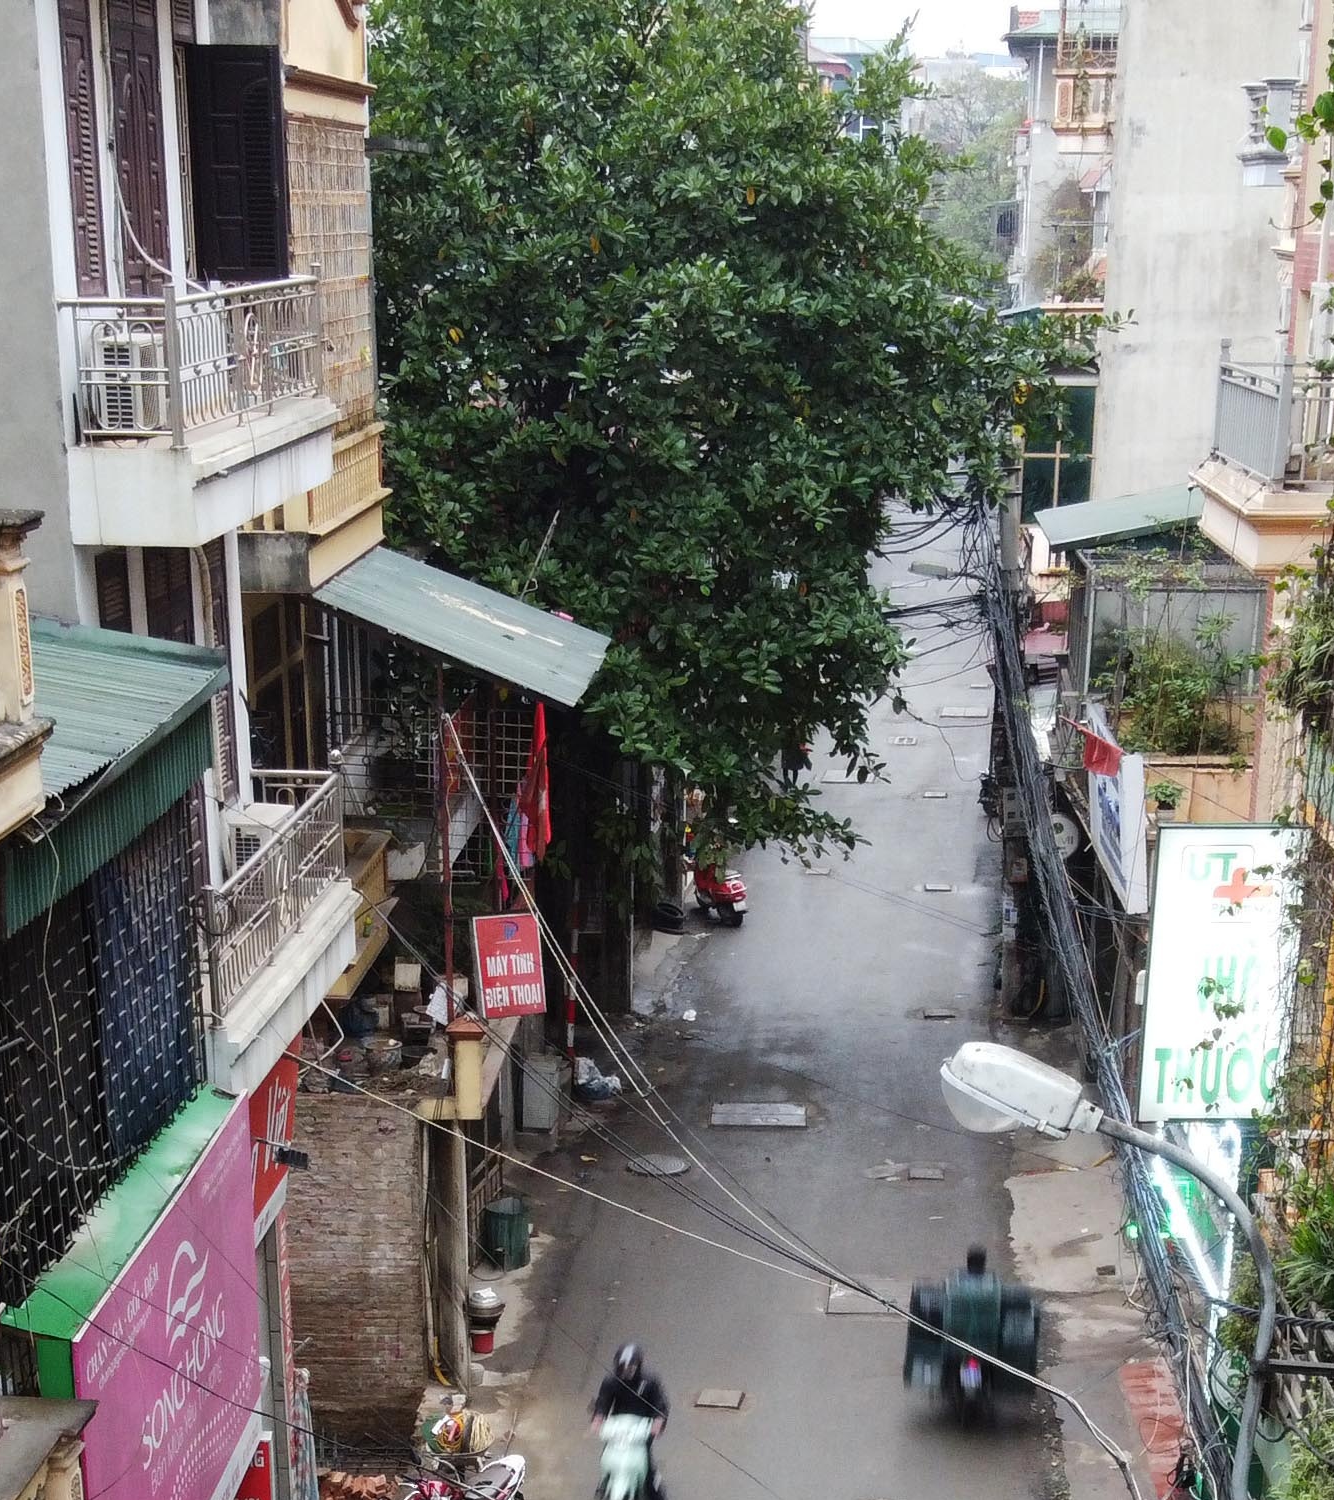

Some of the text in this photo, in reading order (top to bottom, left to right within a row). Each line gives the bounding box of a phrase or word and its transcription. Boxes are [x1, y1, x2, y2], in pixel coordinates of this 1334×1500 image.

[1190, 852, 1238, 882] UT
[486, 948, 535, 978] MÁY TÍNH
[485, 982, 542, 1012] ĐIỆN THOẠI
[1154, 1024, 1281, 1105] THUỐC
